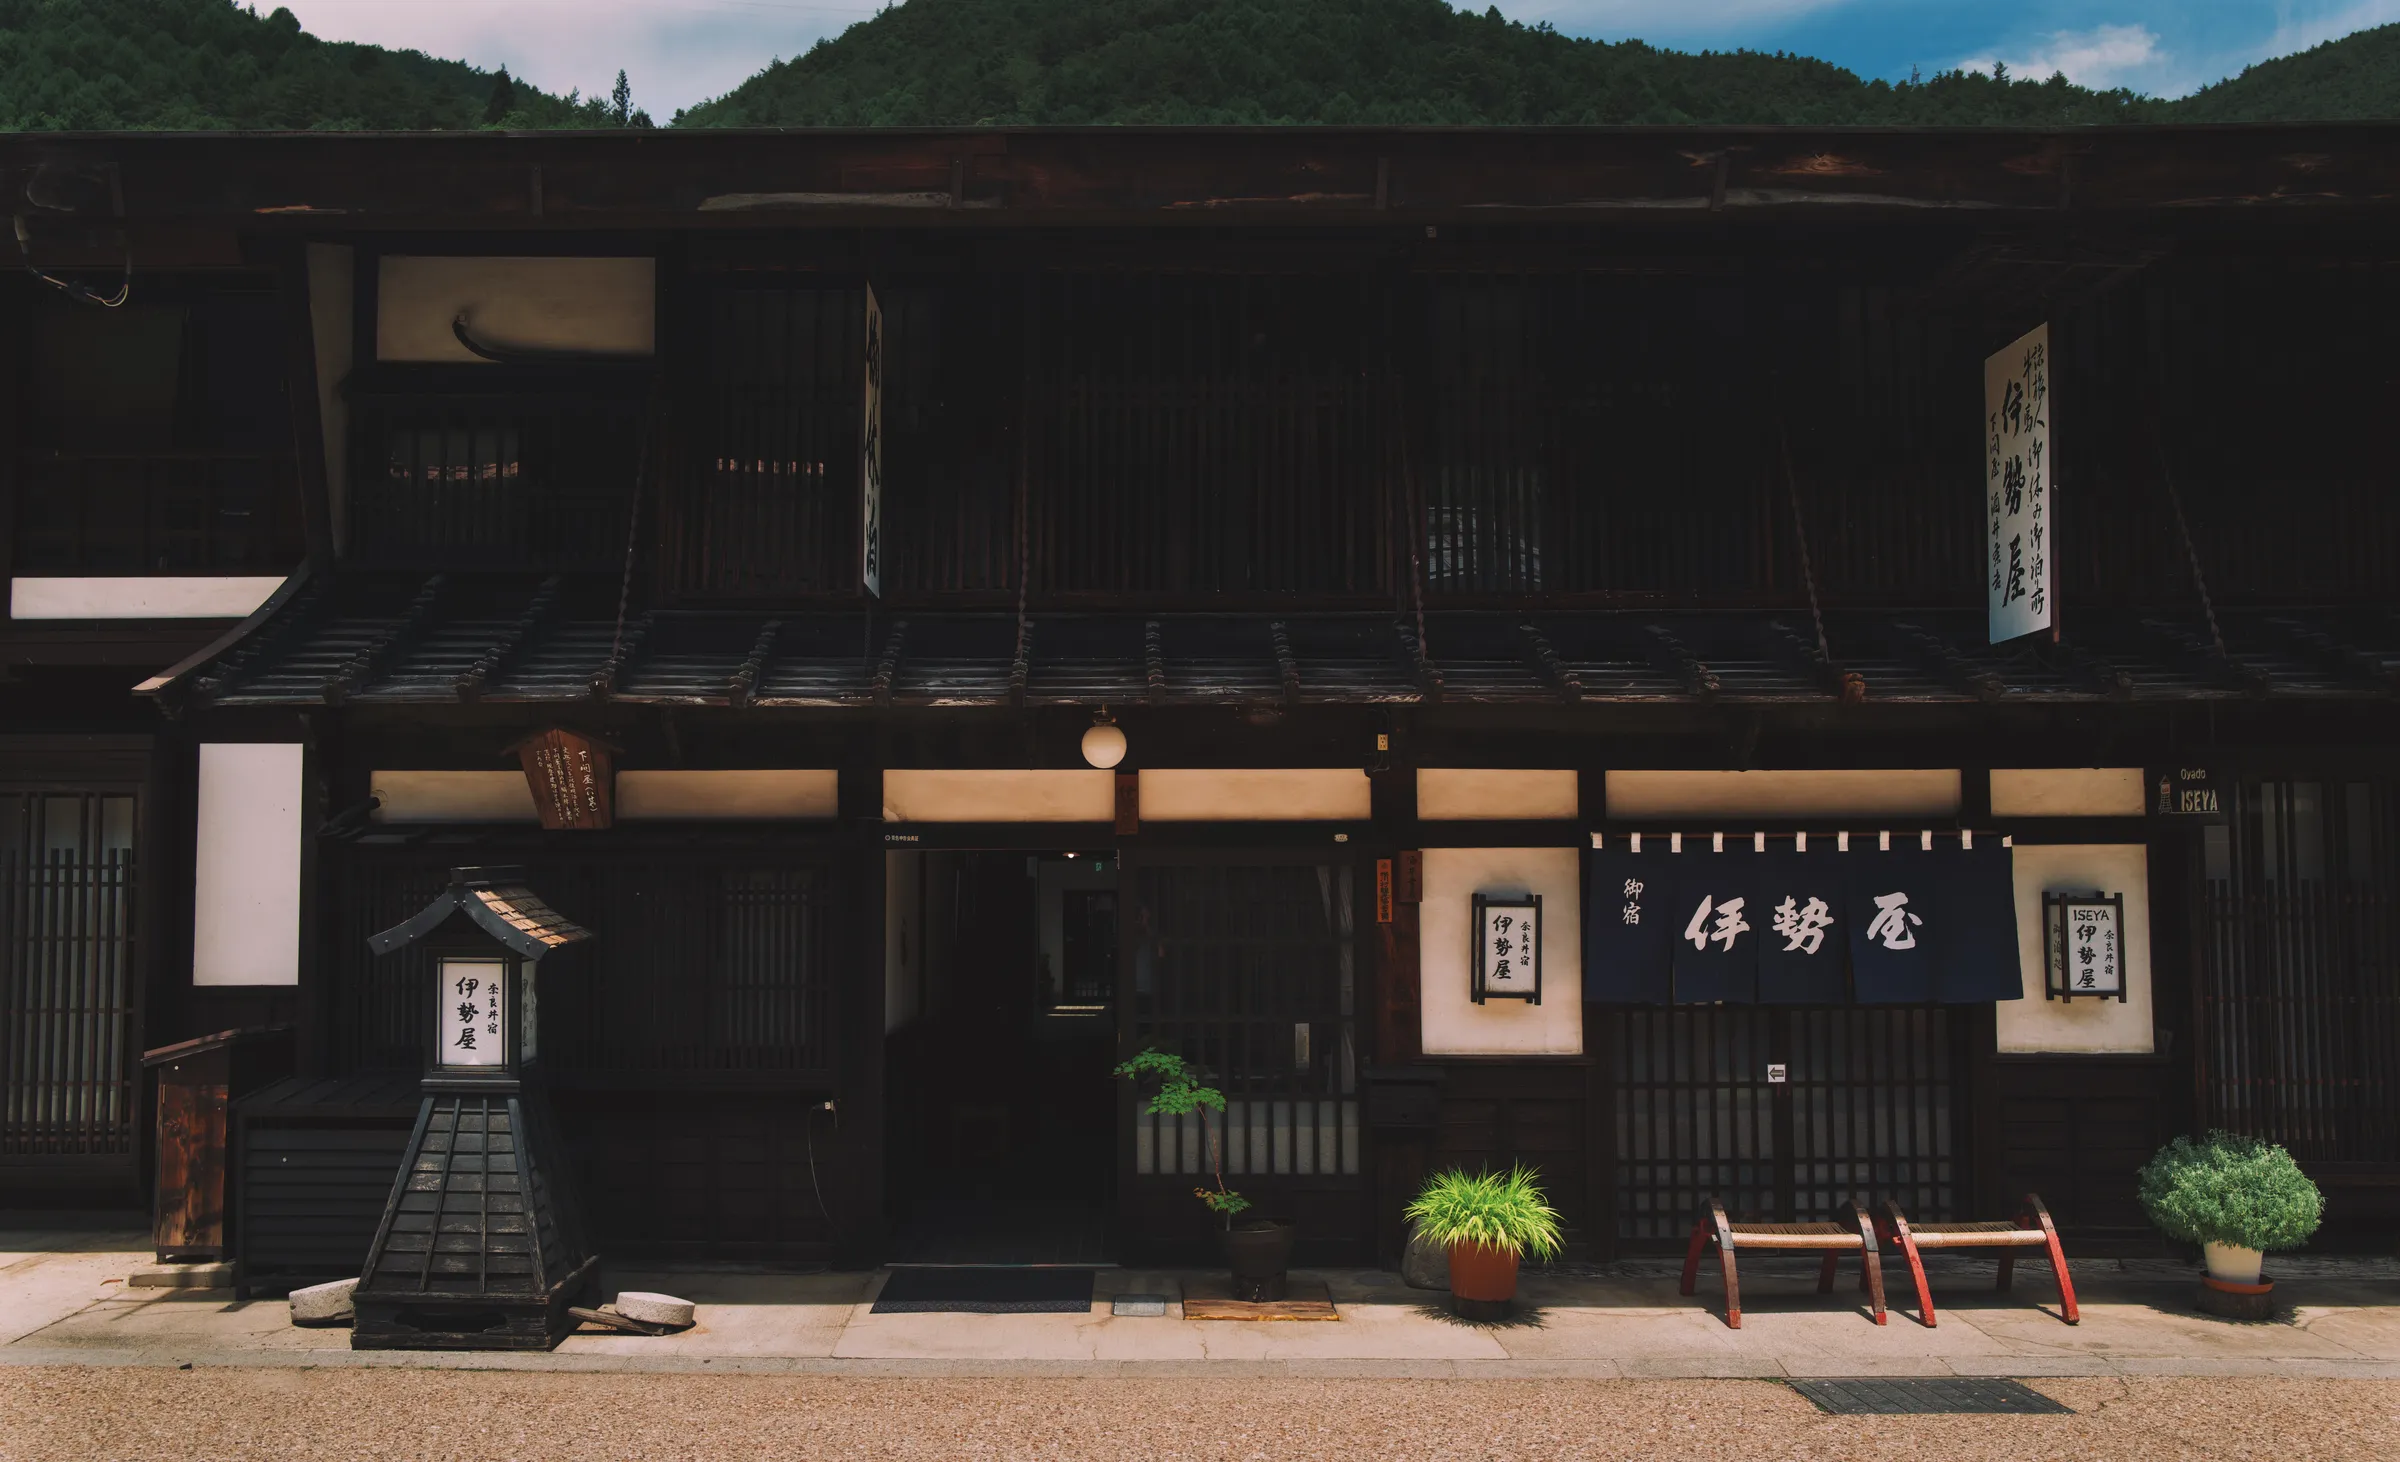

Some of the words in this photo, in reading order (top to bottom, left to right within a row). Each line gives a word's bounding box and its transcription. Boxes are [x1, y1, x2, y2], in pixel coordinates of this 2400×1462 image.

[2002, 378, 2026, 608] 伊勢屋
[2181, 768, 2206, 780] Oyado
[2181, 788, 2218, 811] ISEYA
[1622, 878, 1644, 925] 御宿
[1684, 892, 1923, 955] 伊勢屋
[2073, 909, 2110, 921] ISEYA
[1492, 915, 1514, 979] 伊勢屋
[1520, 921, 1531, 966] 奈良井宿
[2076, 924, 2097, 988] 伊勢屋
[2104, 930, 2115, 975] 奈良井宿
[454, 976, 480, 1050] 伊勢屋
[487, 983, 499, 1035] 奈良井宿
